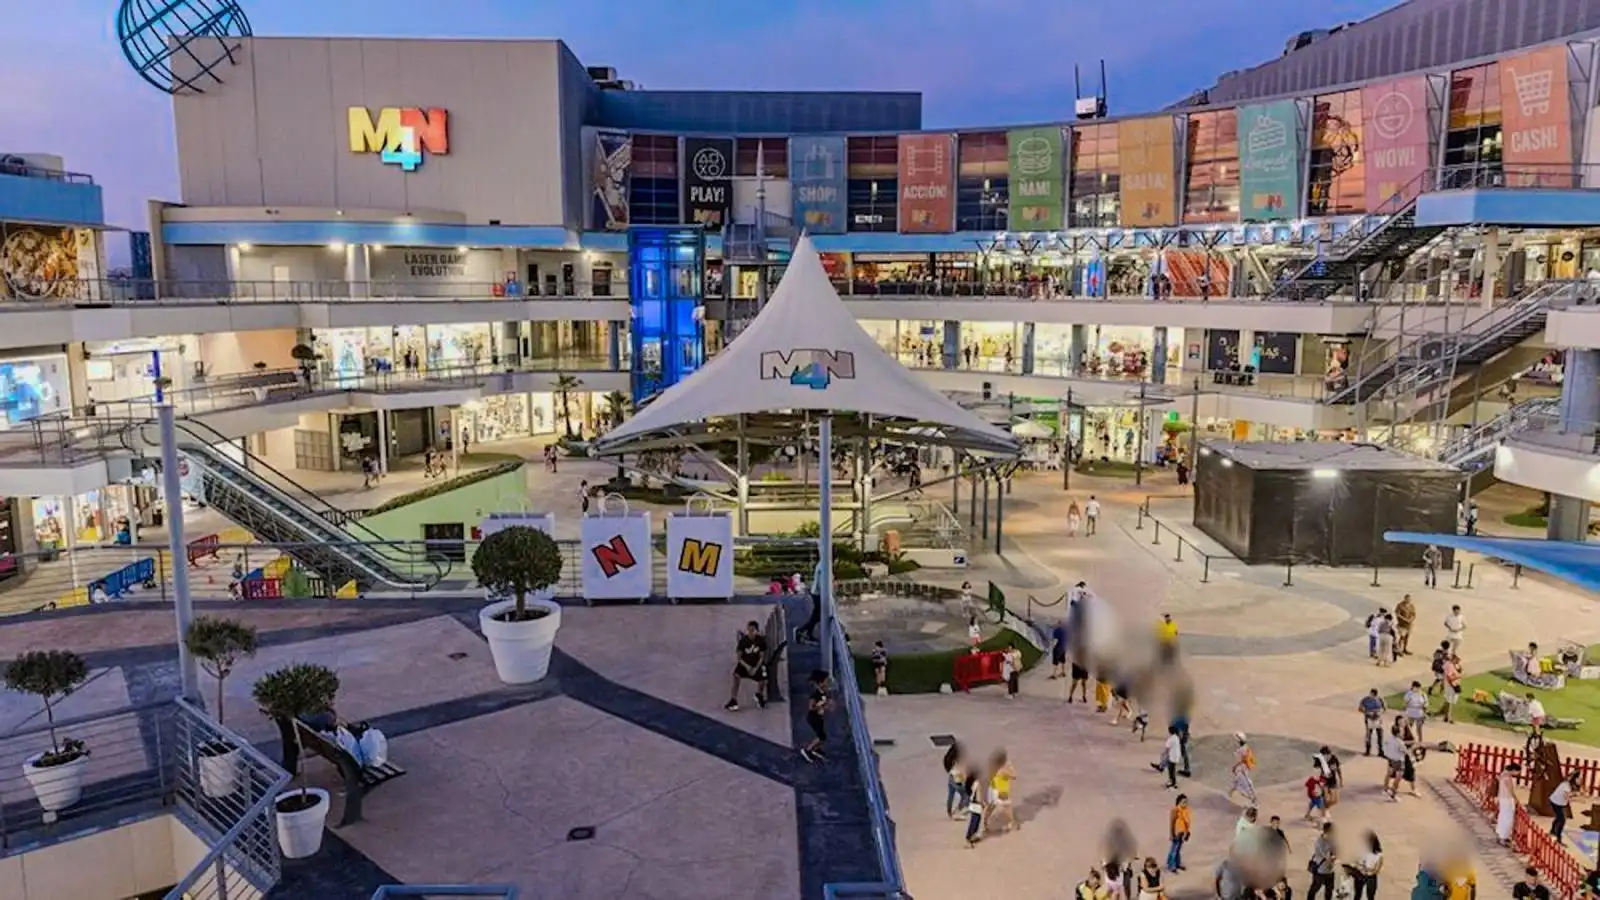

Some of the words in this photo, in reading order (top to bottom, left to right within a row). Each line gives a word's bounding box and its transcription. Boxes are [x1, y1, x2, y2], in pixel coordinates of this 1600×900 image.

[347, 105, 450, 172] M4N
[1511, 125, 1559, 153] CASH!
[1373, 147, 1416, 169] WOW!
[690, 185, 725, 203] PLAY!
[799, 185, 837, 202] SHOP!
[903, 181, 948, 199] ACCIÓN!
[404, 252, 438, 266] LASER
[760, 347, 856, 390] M4N
[591, 534, 638, 580] N
[678, 537, 723, 578] M
